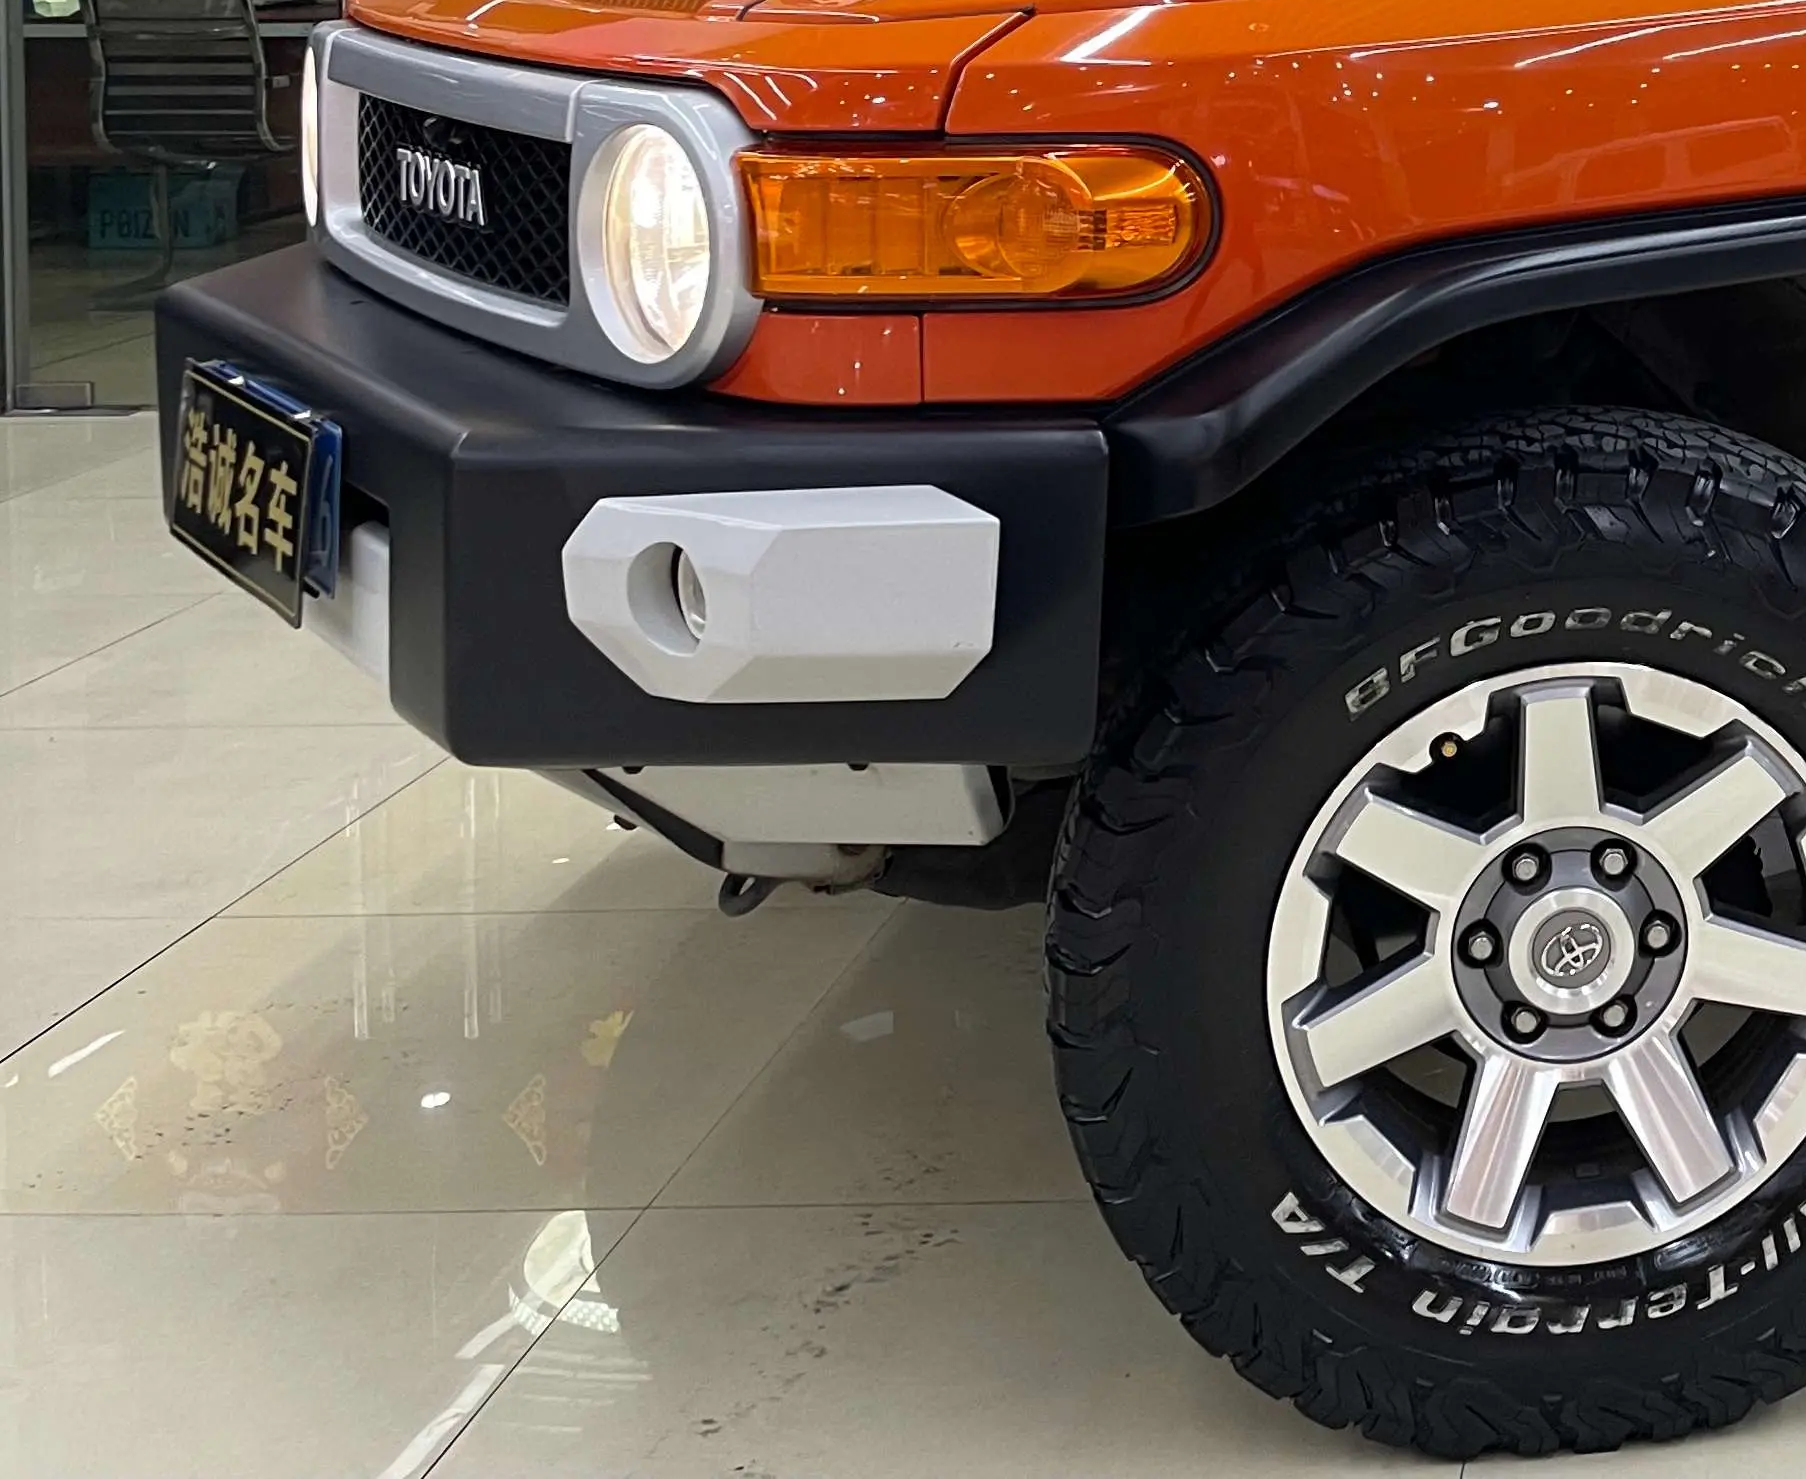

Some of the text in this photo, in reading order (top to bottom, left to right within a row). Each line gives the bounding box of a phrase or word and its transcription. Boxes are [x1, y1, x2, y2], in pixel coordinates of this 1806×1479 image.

[396, 148, 485, 226] TOYOTA
[181, 406, 298, 573] 浩诚名车
[1271, 1190, 1377, 1294] T/A
